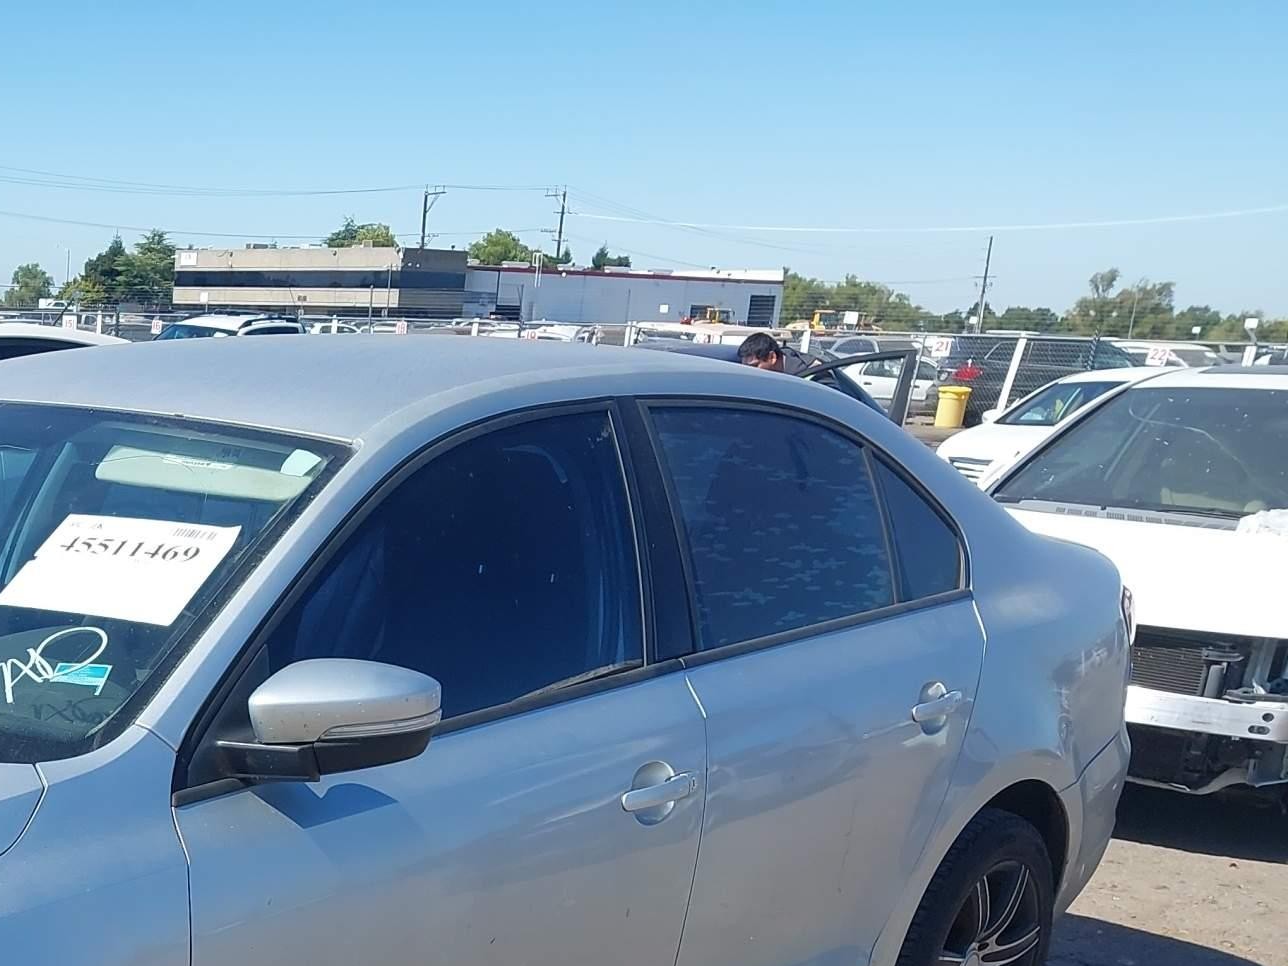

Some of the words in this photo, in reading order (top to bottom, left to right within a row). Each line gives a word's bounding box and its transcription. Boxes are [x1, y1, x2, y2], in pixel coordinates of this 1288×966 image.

[935, 340, 950, 352] 21
[1150, 348, 1168, 360] 22
[59, 536, 201, 562] 45511469
